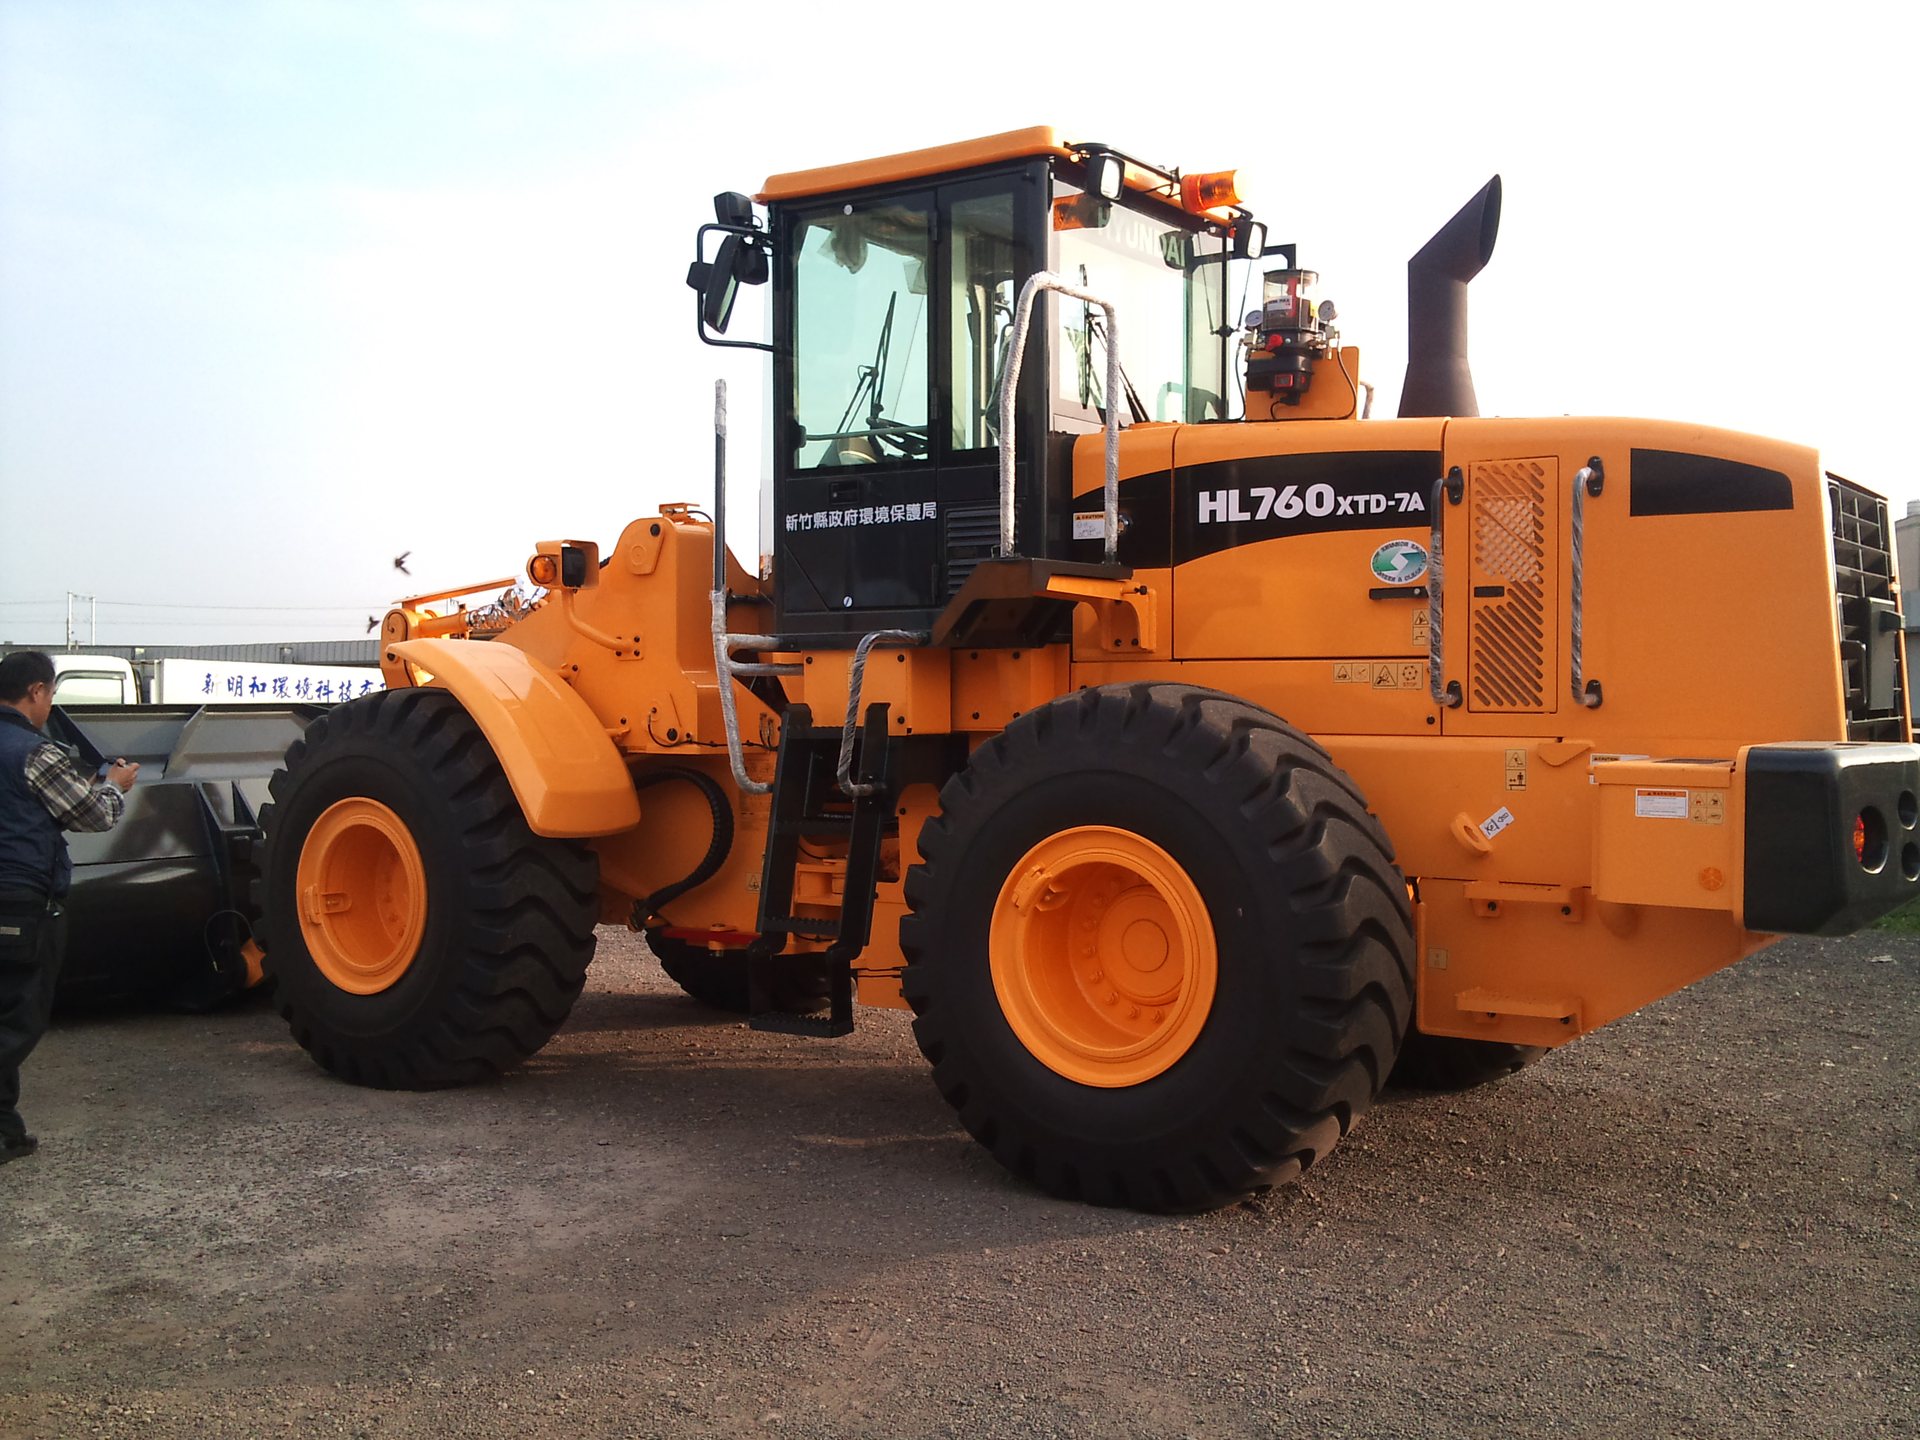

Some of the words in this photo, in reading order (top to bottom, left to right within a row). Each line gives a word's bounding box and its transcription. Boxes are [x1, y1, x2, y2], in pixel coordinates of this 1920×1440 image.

[1098, 206, 1186, 268] HYUNDAI
[785, 501, 937, 532] 新竹縣政府環境保護局
